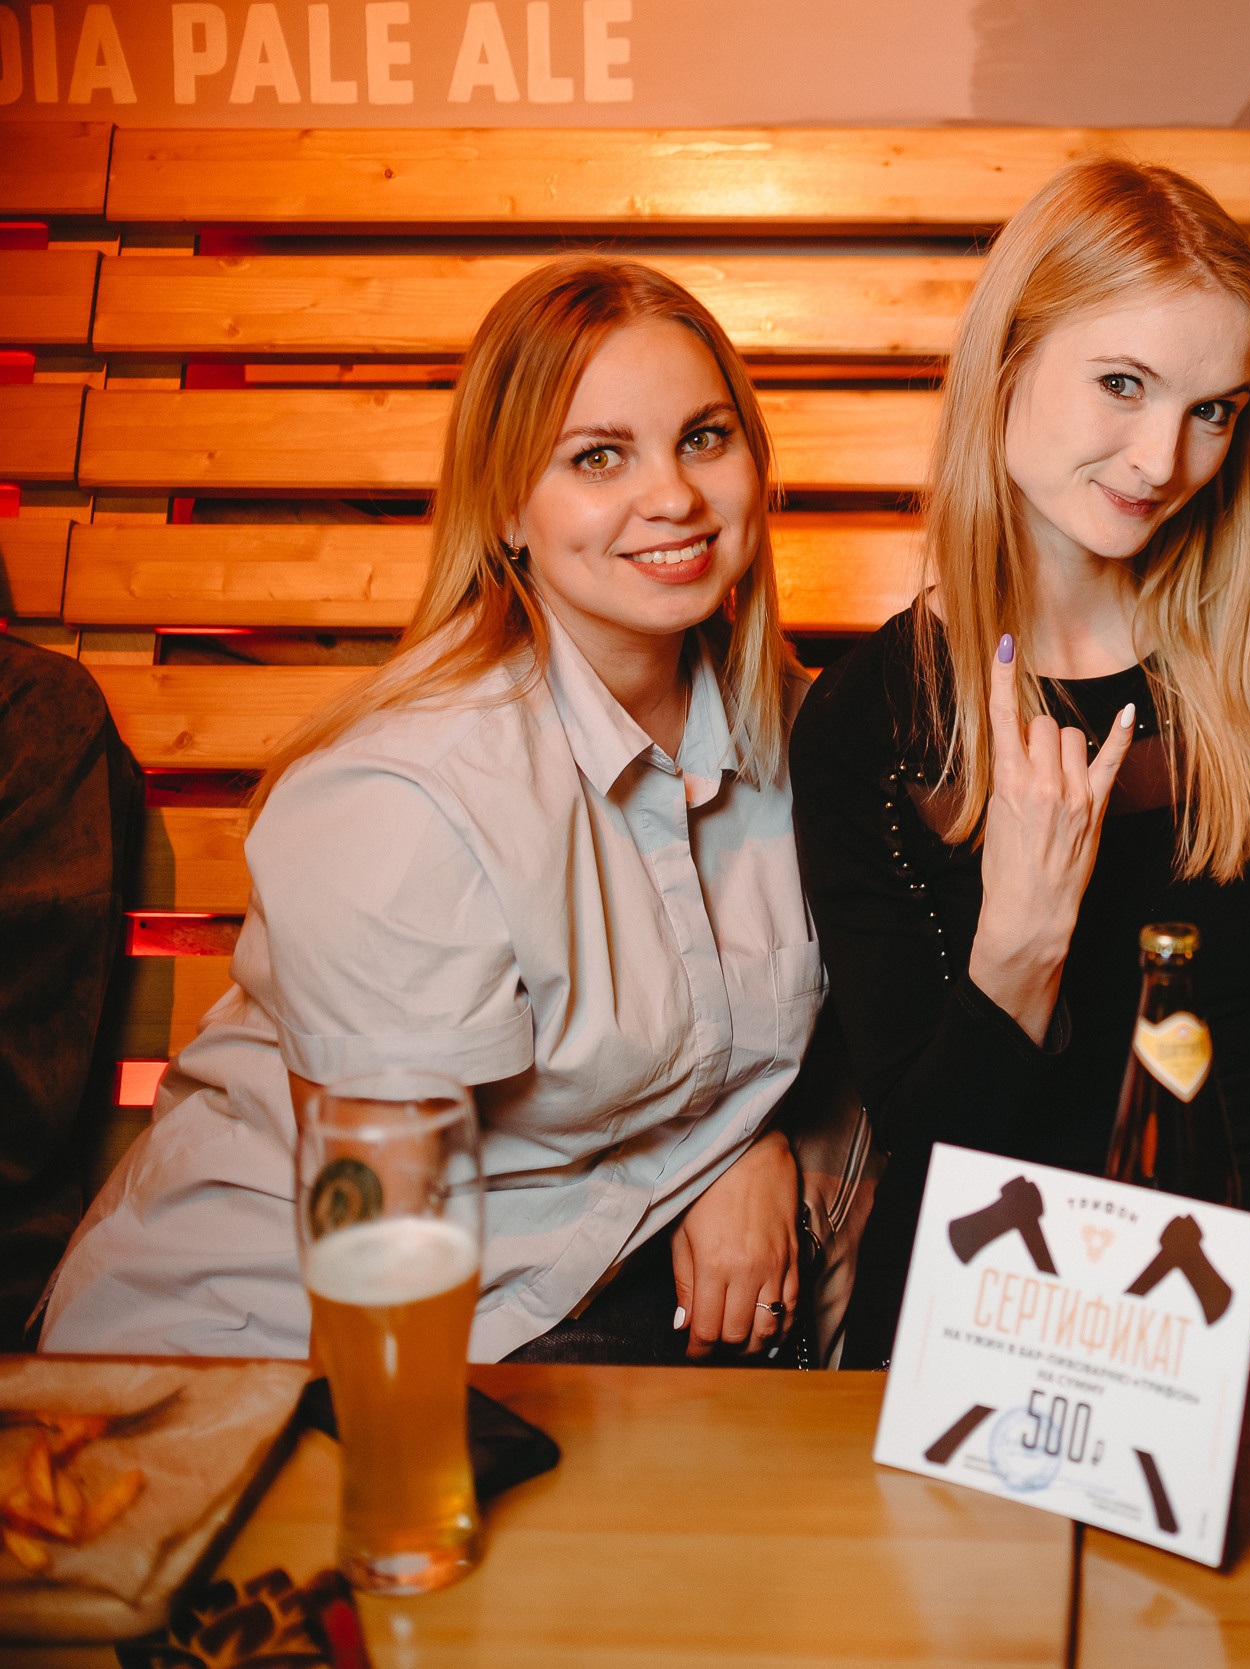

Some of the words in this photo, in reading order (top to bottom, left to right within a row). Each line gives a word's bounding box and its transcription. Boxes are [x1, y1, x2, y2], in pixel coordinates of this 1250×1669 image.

[172, 1, 414, 104] PALE
[447, 0, 633, 103] ALE
[1067, 1197, 1139, 1224] ТРИФОН
[974, 1267, 1193, 1378] СЕРТИФИКАТ
[1021, 1389, 1092, 1463] 500
